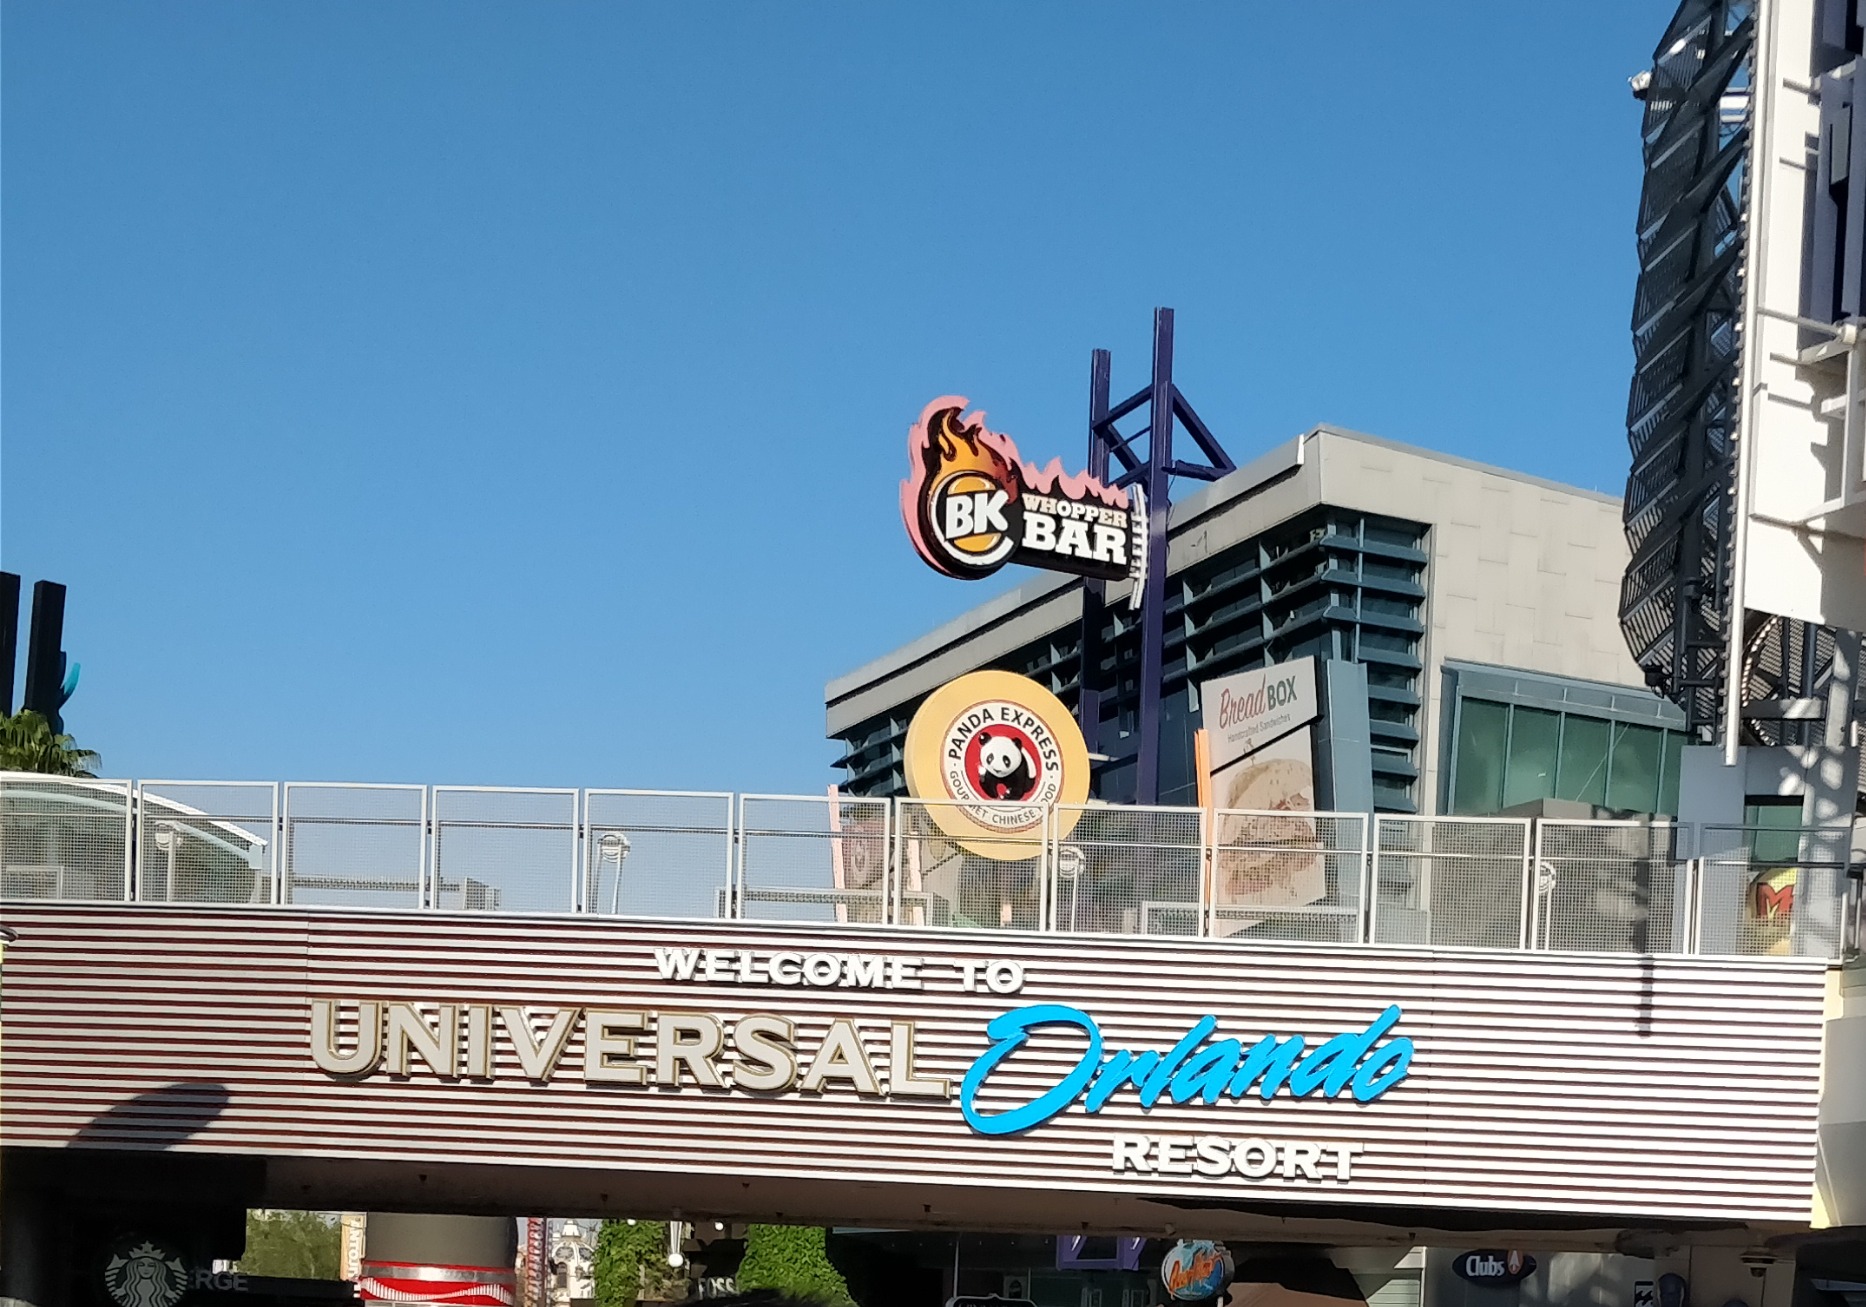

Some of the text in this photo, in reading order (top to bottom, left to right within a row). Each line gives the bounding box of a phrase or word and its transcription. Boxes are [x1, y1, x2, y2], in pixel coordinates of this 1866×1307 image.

[945, 490, 1009, 539] BK
[1021, 492, 1127, 528] WHOPPER
[1022, 511, 1127, 565] BAR
[1219, 673, 1297, 729] Bread BOX
[948, 707, 1059, 772] PANDA EXPRESS
[992, 809, 1036, 825] CHINESE
[654, 947, 1026, 994] WELCOME TO
[310, 1000, 1415, 1135] UNIVERSAL Orlando
[1112, 1133, 1364, 1182] RESORT
[1466, 1255, 1505, 1276] Clubs
